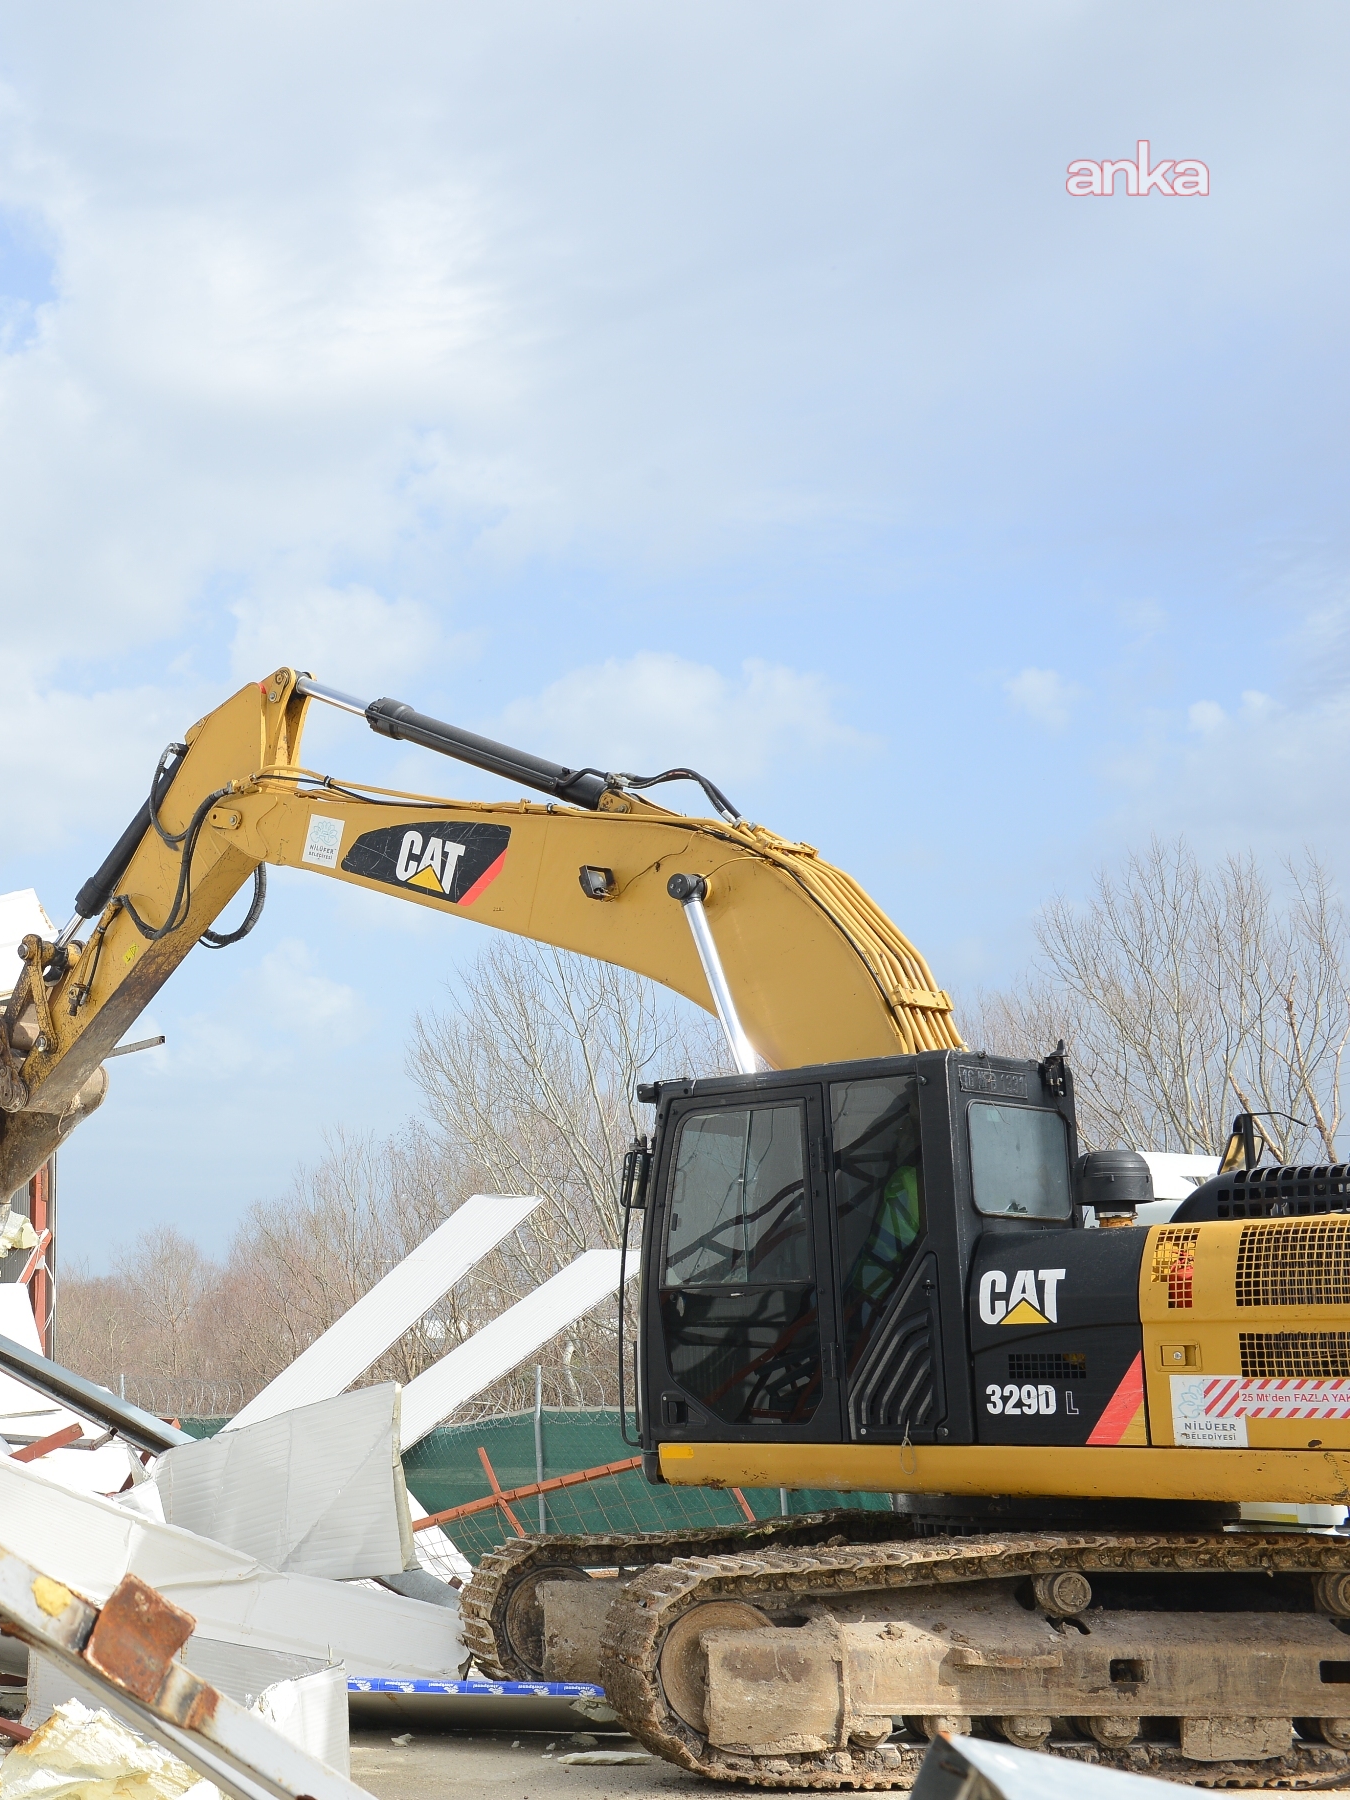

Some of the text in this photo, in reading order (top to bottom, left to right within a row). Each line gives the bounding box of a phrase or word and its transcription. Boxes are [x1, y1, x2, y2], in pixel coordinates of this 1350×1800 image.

[395, 830, 466, 895] CAT
[979, 1268, 1066, 1325] CAT
[985, 1384, 1080, 1415] 329D L
[1241, 1393, 1253, 1402] 25
[1184, 1421, 1237, 1431] NİLÜFER
